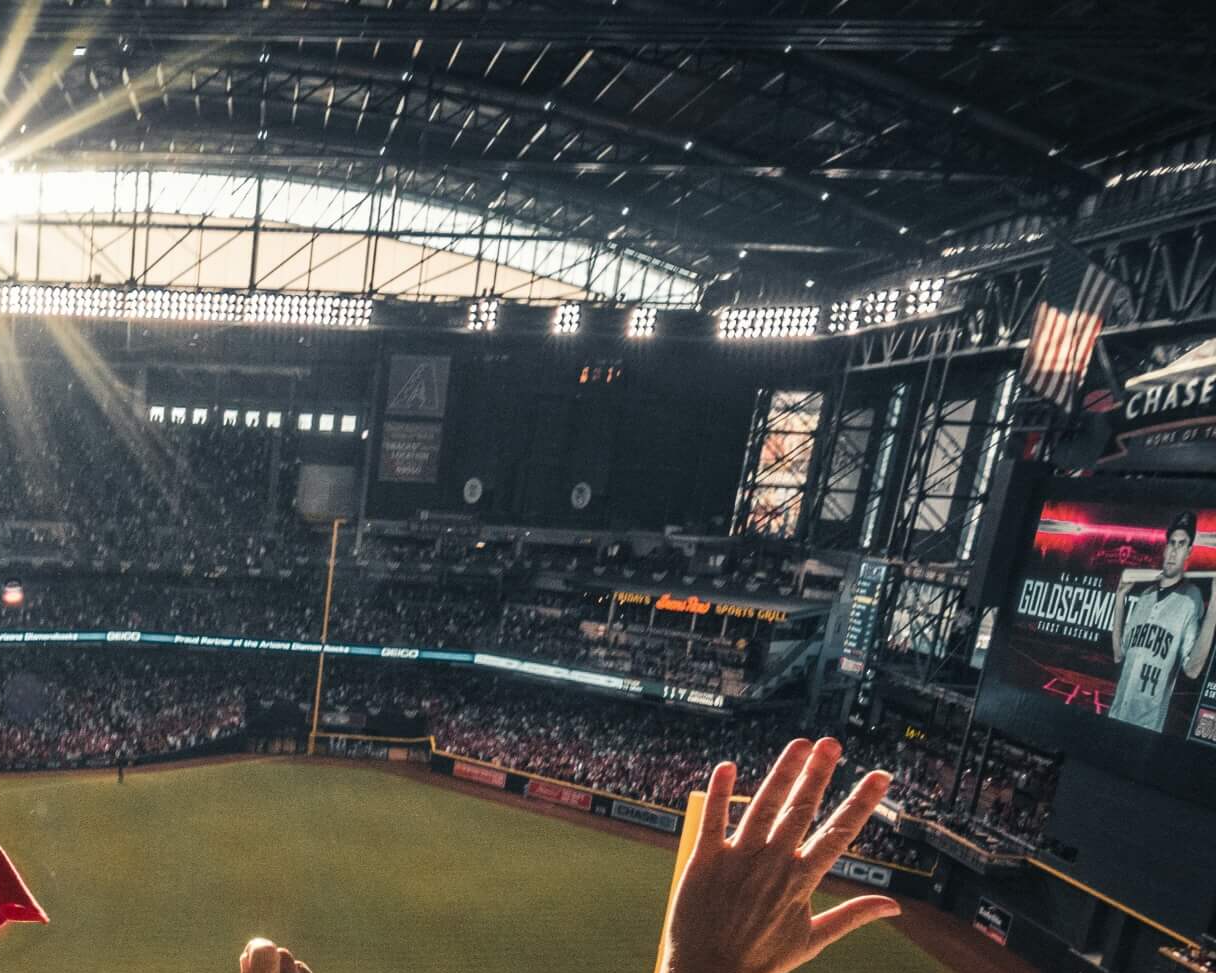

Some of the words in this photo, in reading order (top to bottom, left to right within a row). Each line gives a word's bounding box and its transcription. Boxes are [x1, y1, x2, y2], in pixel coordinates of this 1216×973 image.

[1125, 374, 1216, 420] CHASE
[1017, 579, 1139, 632] GOLDSCHMIT
[106, 631, 141, 642] GEICO
[1063, 625, 1100, 642] BASEMAN
[291, 642, 349, 653] Diamonbacks
[381, 647, 419, 659] GEICO
[1140, 663, 1162, 696] 44
[832, 858, 889, 888] EICO
